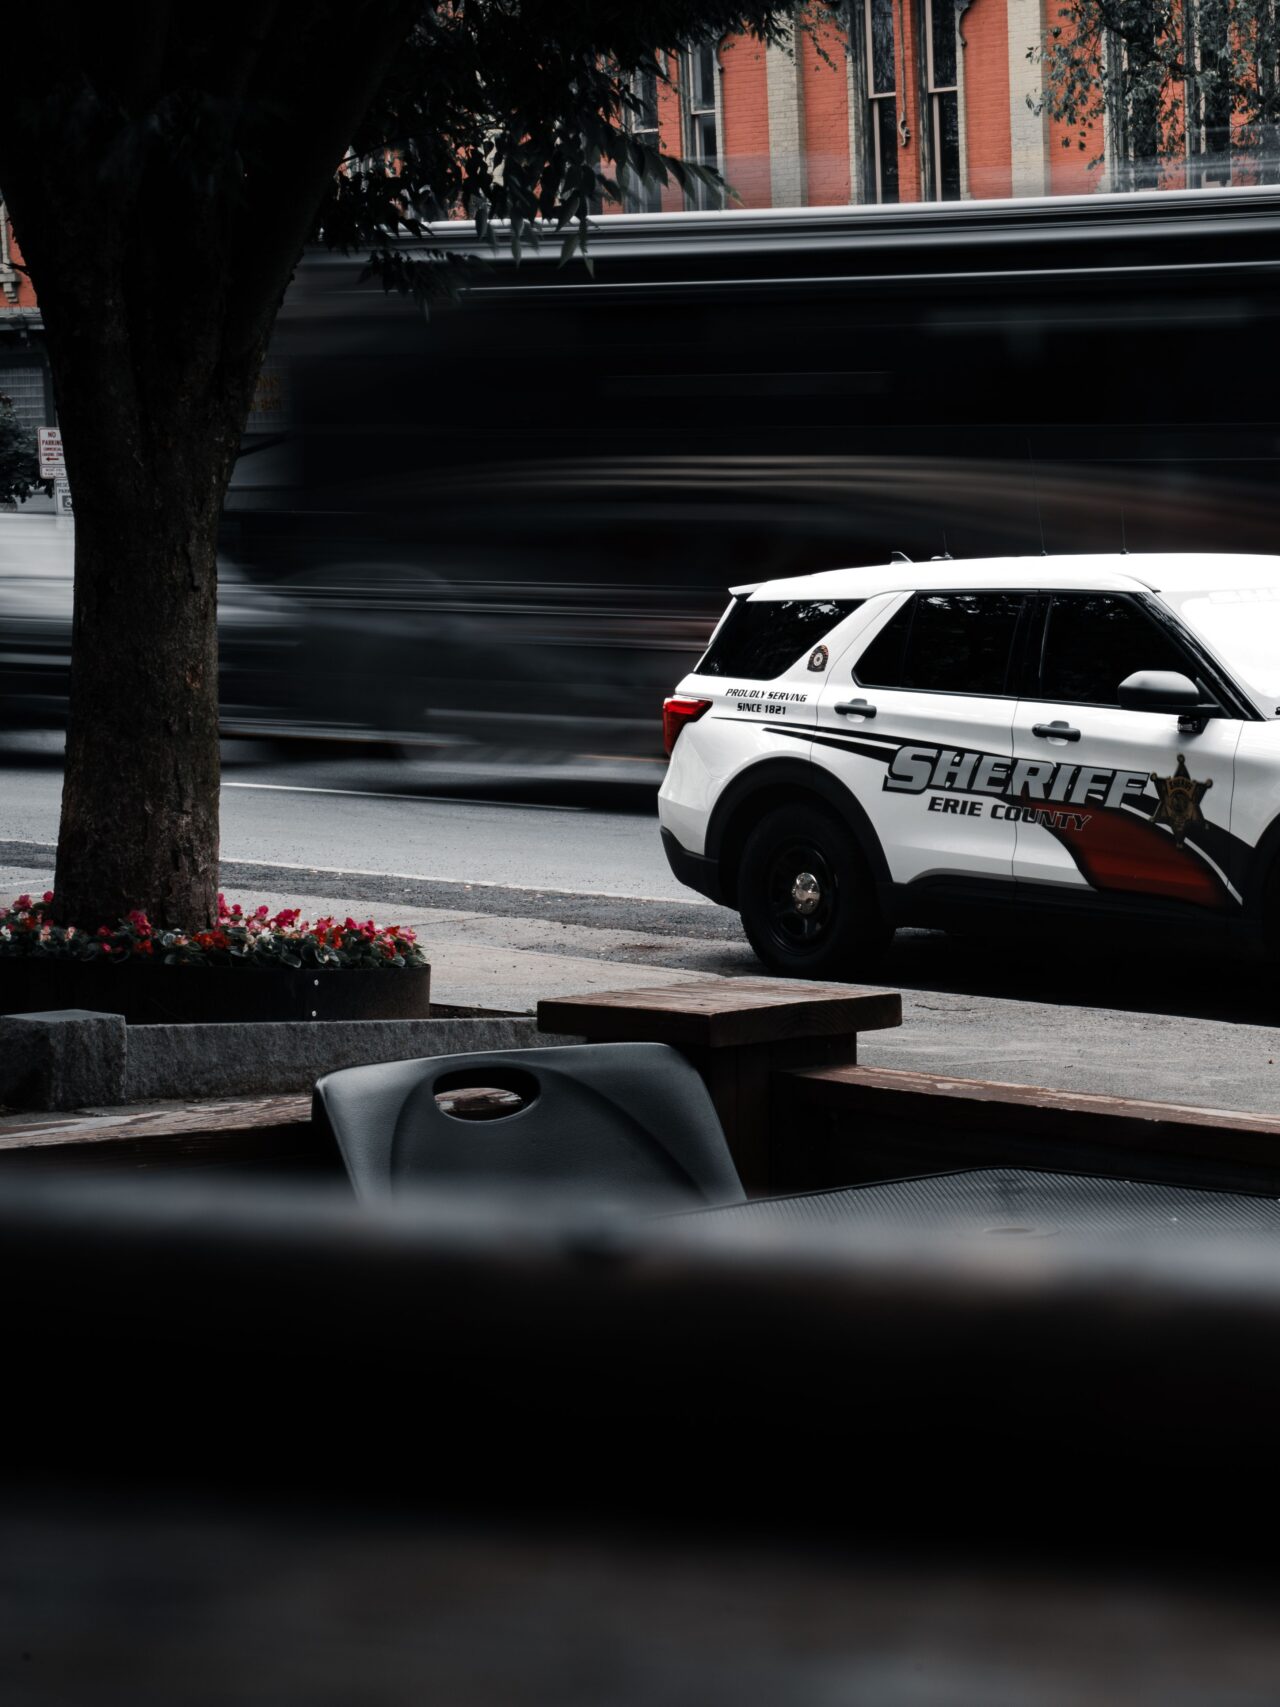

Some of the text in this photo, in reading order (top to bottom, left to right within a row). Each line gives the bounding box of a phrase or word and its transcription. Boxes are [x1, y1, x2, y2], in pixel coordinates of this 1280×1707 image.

[725, 688, 808, 702] PROUDLY SERVING
[737, 702, 786, 715] SINCE 1821
[883, 745, 1151, 809] SHERIFF
[928, 797, 1092, 832] ERIE COUNTY
